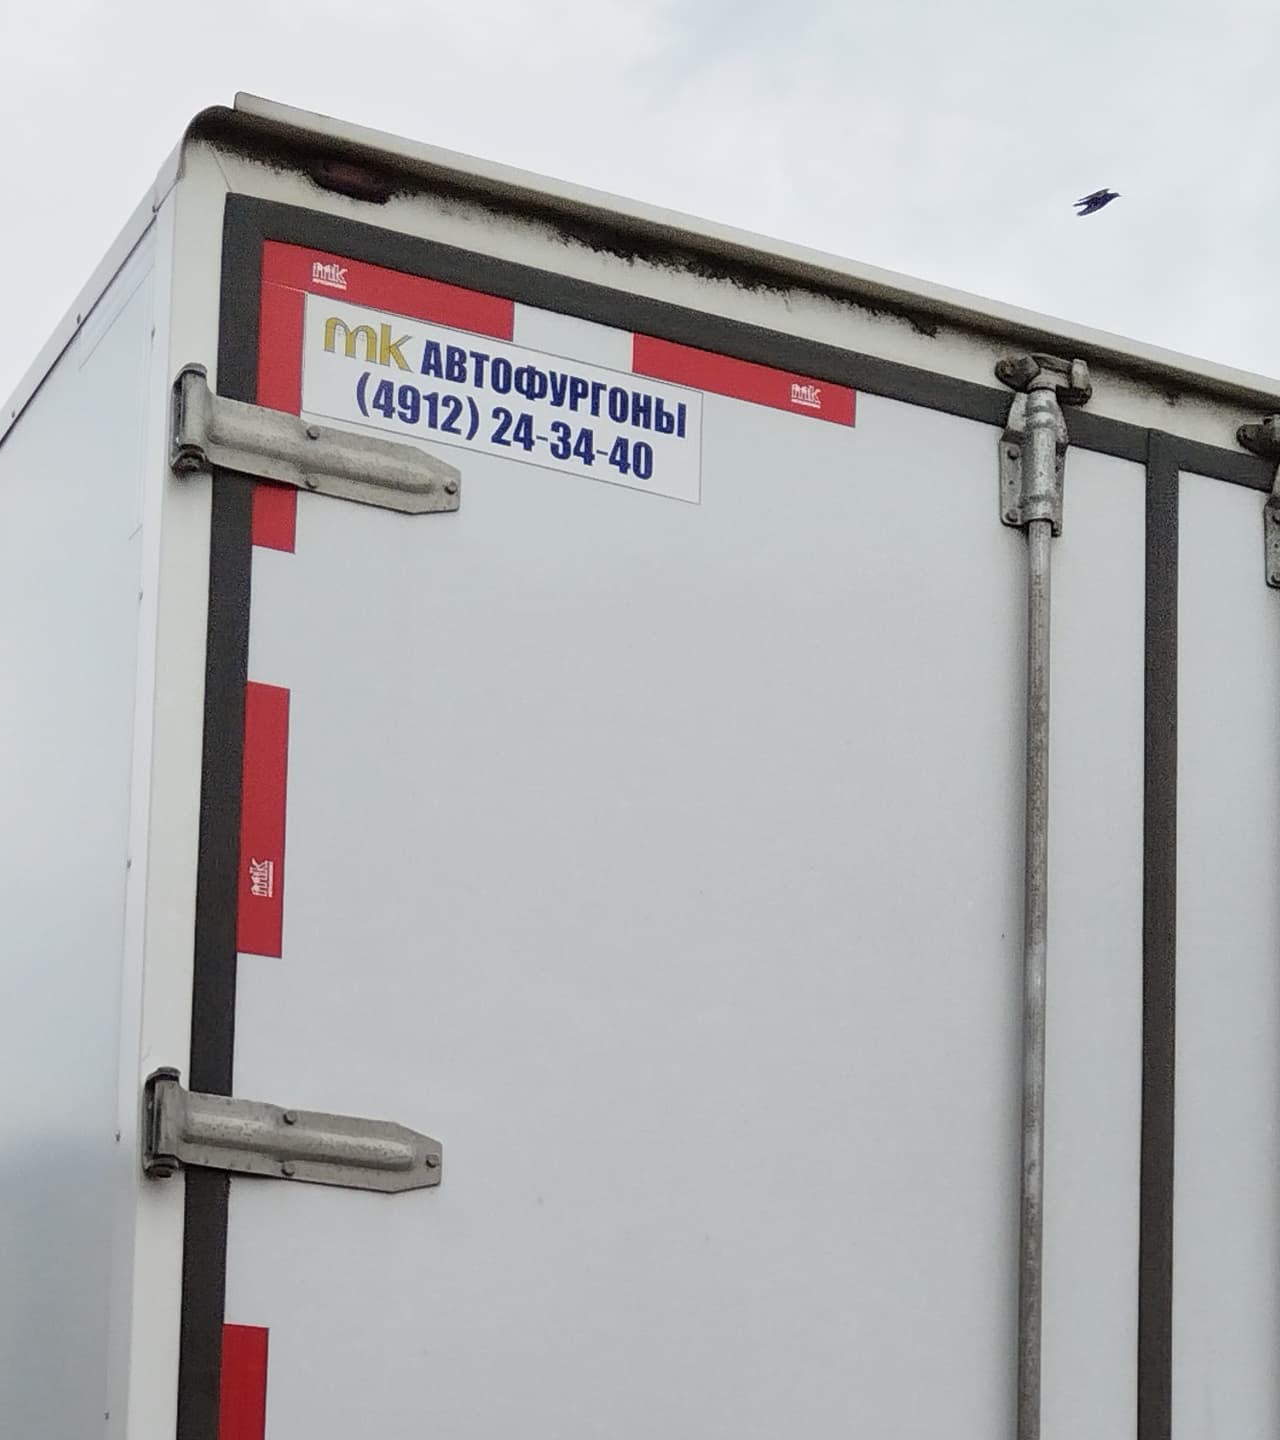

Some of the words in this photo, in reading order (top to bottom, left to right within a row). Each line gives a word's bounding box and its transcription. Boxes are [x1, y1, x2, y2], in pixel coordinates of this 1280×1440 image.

[356, 371, 480, 441] (4912)
[491, 406, 654, 480] 24-34-40
[421, 339, 687, 439] АВТОФУРГОНЫ
